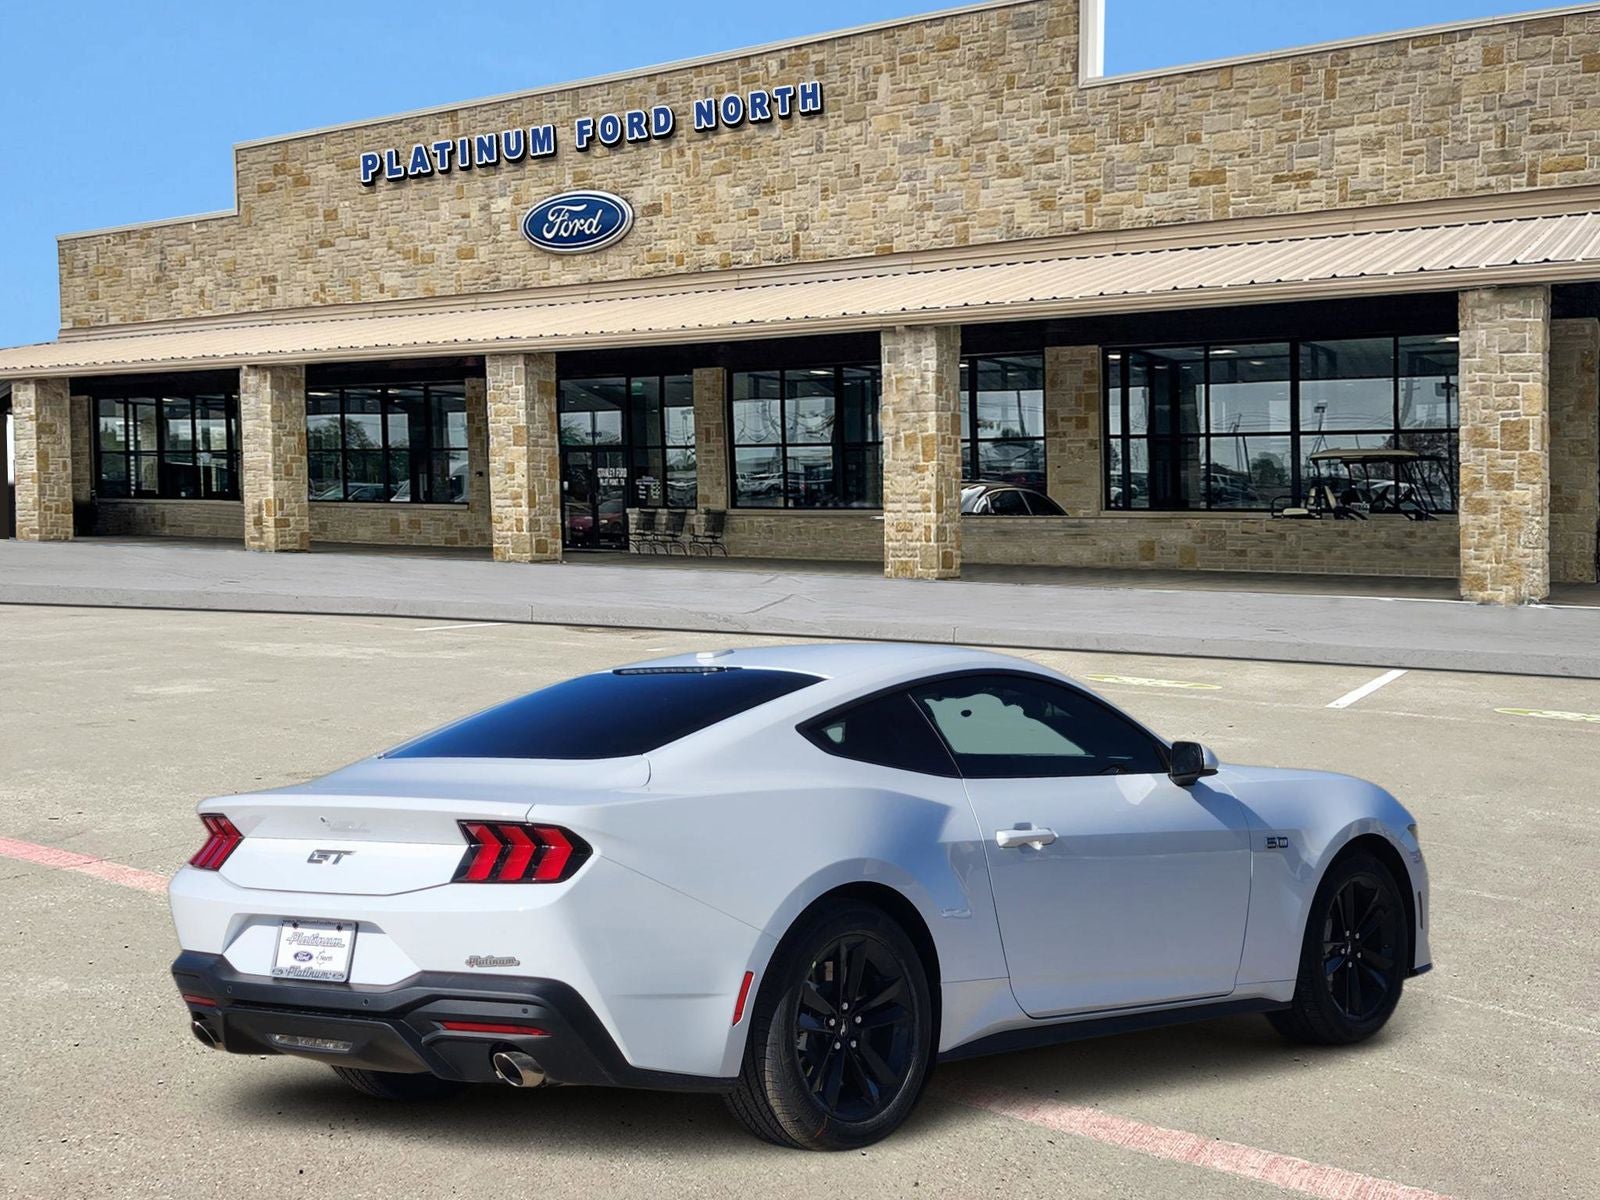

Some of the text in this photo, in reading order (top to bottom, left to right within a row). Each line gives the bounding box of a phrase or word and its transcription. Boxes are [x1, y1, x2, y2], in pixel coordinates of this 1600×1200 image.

[360, 81, 823, 184] PLATINUM FORD NORTH
[542, 203, 604, 239] Ford
[1267, 837, 1288, 849] 5.0
[307, 849, 357, 865] GT
[286, 932, 345, 948] Platinum
[296, 951, 312, 961] Ford
[465, 955, 520, 968] Platinum
